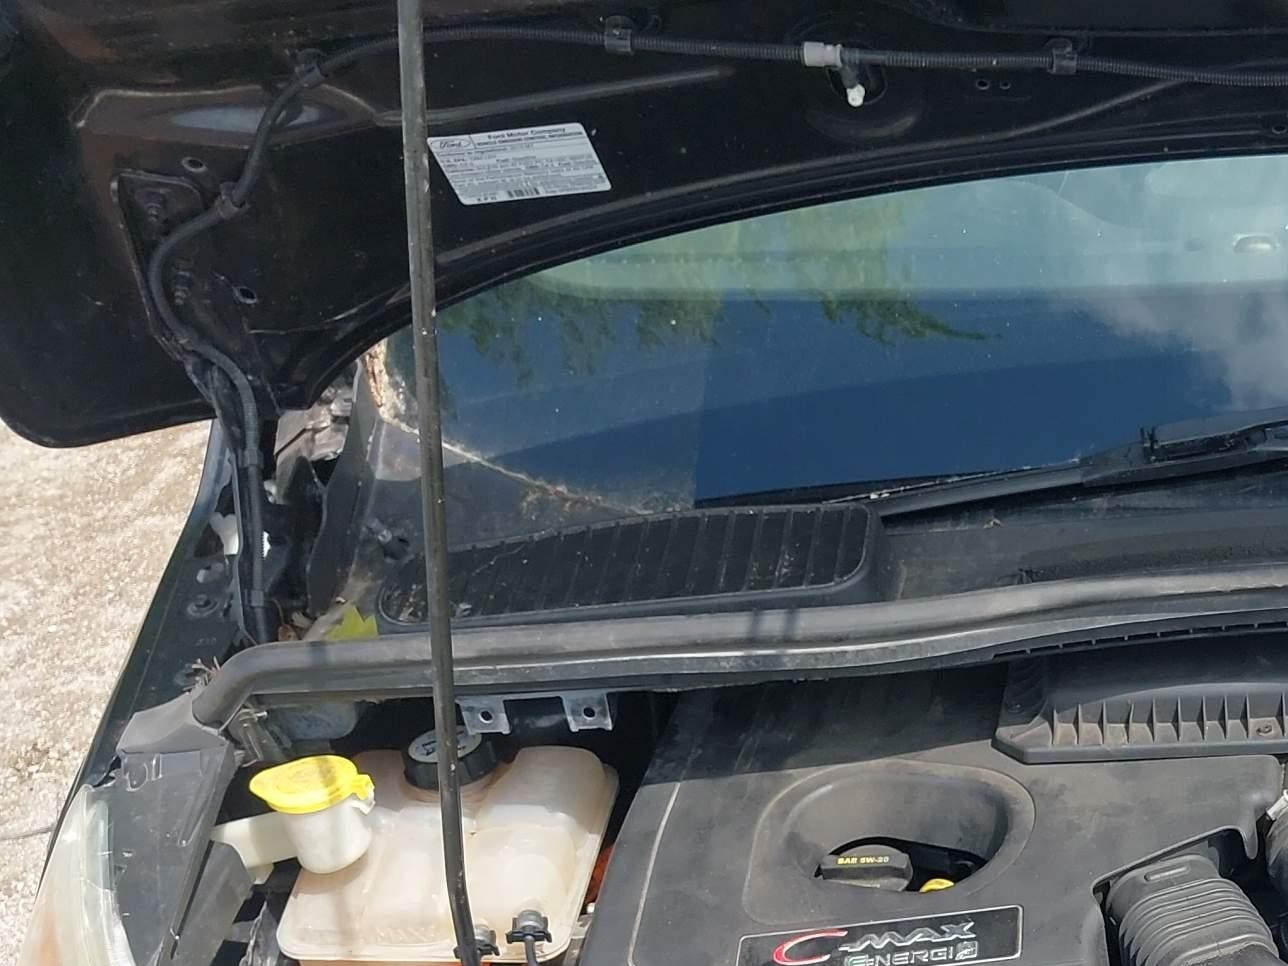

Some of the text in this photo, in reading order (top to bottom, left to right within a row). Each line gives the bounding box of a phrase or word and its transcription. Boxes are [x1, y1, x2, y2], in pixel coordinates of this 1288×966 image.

[487, 127, 566, 140] Ford Motor Company
